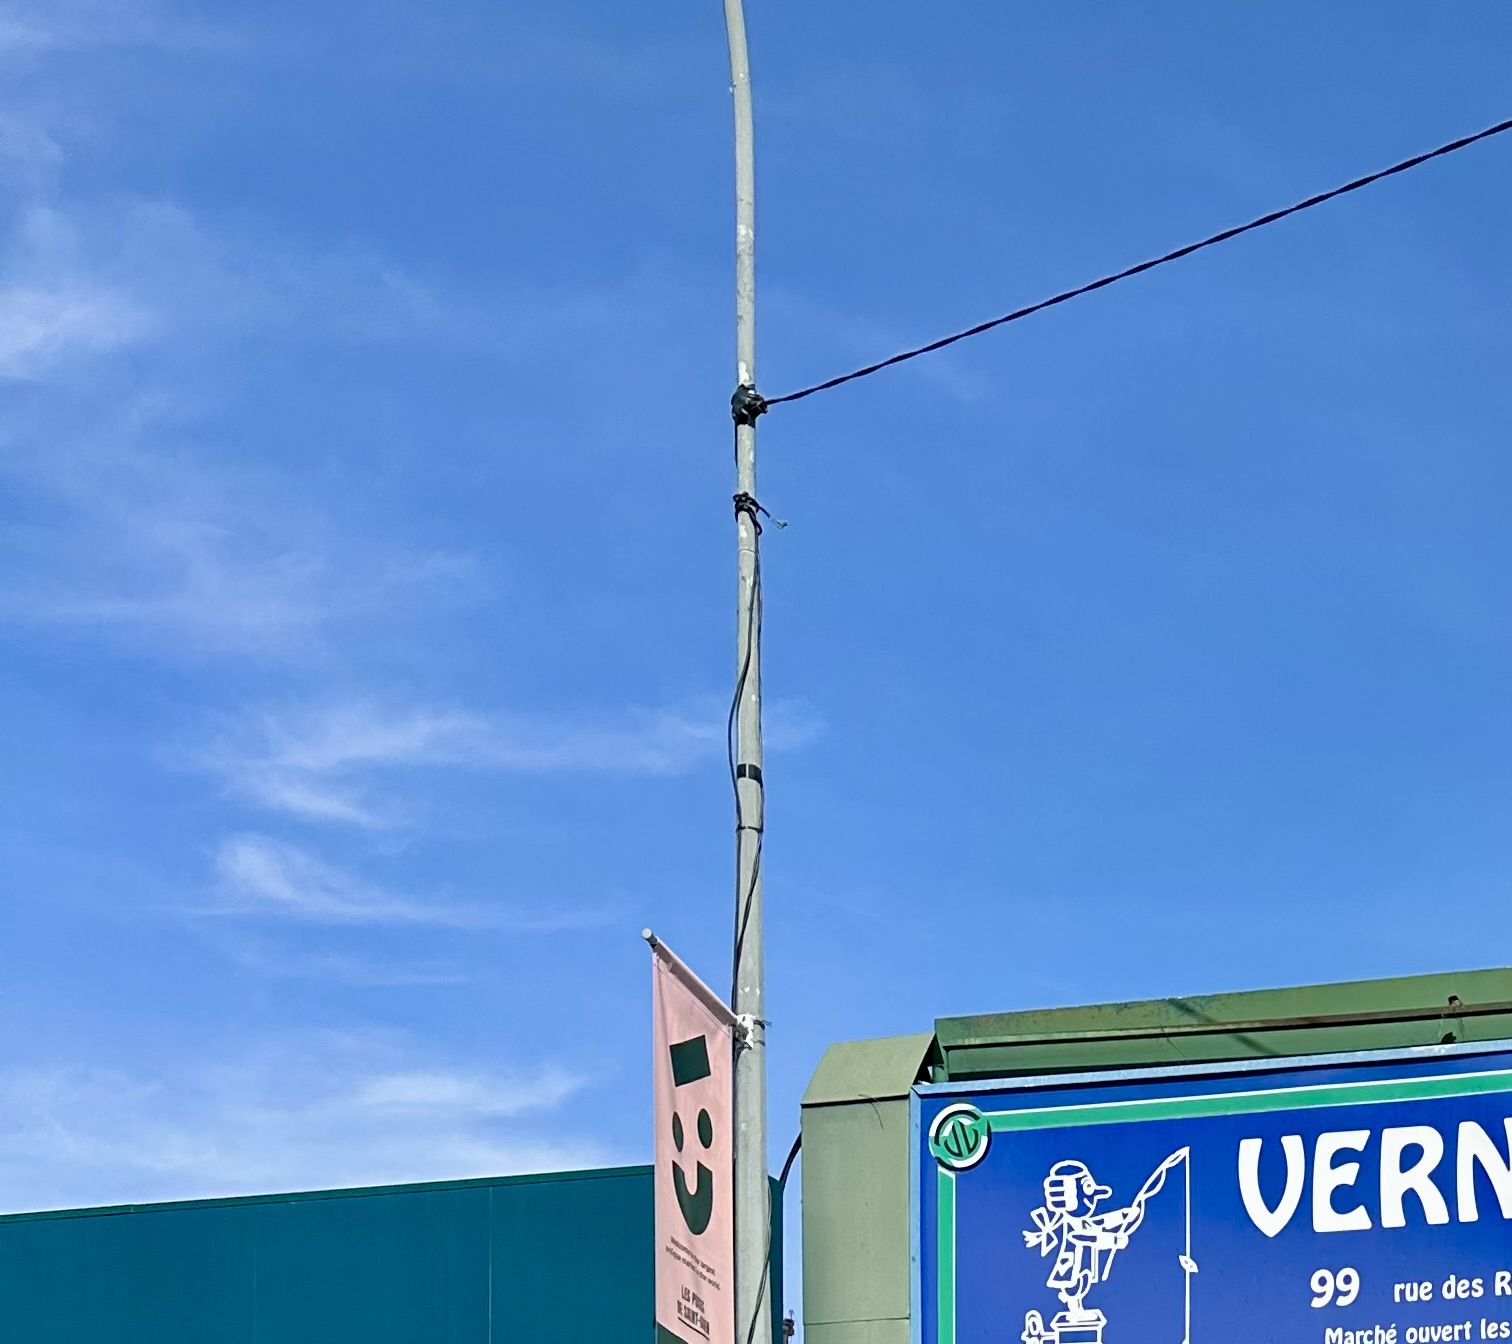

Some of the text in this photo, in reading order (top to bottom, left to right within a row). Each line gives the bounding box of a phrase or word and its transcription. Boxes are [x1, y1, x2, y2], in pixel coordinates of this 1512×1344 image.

[1310, 1267, 1360, 1309] 99
[1394, 1281, 1433, 1303] rue
[1441, 1274, 1485, 1300] des
[1405, 1321, 1472, 1344] ouvert
[1480, 1318, 1511, 1340] les
